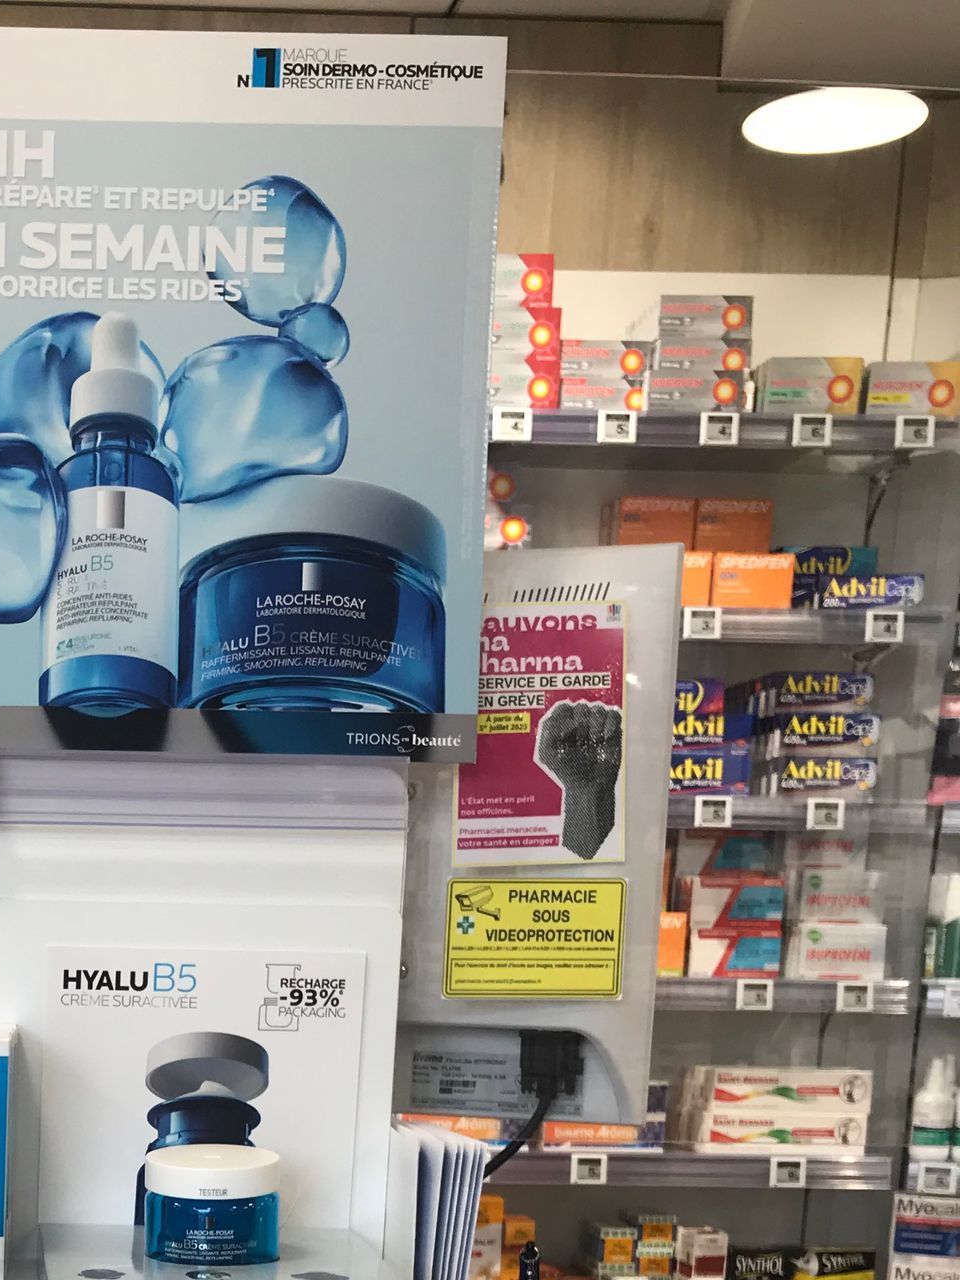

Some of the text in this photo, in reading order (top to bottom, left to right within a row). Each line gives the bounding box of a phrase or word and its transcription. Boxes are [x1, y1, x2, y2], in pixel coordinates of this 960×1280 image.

[282, 48, 347, 64] MARQUE
[282, 63, 320, 77] SOIN
[282, 77, 353, 90] PRESCRITE
[356, 78, 375, 90] EN
[104, 186, 138, 209] ET
[18, 220, 287, 274] SEMAINE
[106, 277, 156, 300] LES
[57, 555, 114, 581] HYALU B5
[256, 593, 367, 610] LA ROCHE-POSAY
[256, 606, 367, 620] LABORATOIRE DERMATOLOGIQUE
[482, 613, 597, 633] auvons
[253, 623, 286, 648] B5
[290, 628, 338, 645] CRÈME
[481, 654, 583, 673] harma
[478, 673, 611, 690] SERVICE DE GARDE
[478, 692, 545, 708] EN GRÈVE
[346, 732, 400, 746] TRIONS
[412, 733, 462, 748] beauté
[508, 889, 598, 904] PHARMACIE
[532, 909, 570, 923] SOUS
[485, 929, 615, 943] VIDEOPROTECTION
[62, 963, 197, 993] HYALU B5
[279, 977, 346, 990] RECHARGE
[60, 992, 198, 1010] CRÈME SURACTIVÉE
[278, 1006, 346, 1019] PACKAGING
[198, 1188, 229, 1197] TESTEUR
[736, 1254, 784, 1277] SYNTHOL
